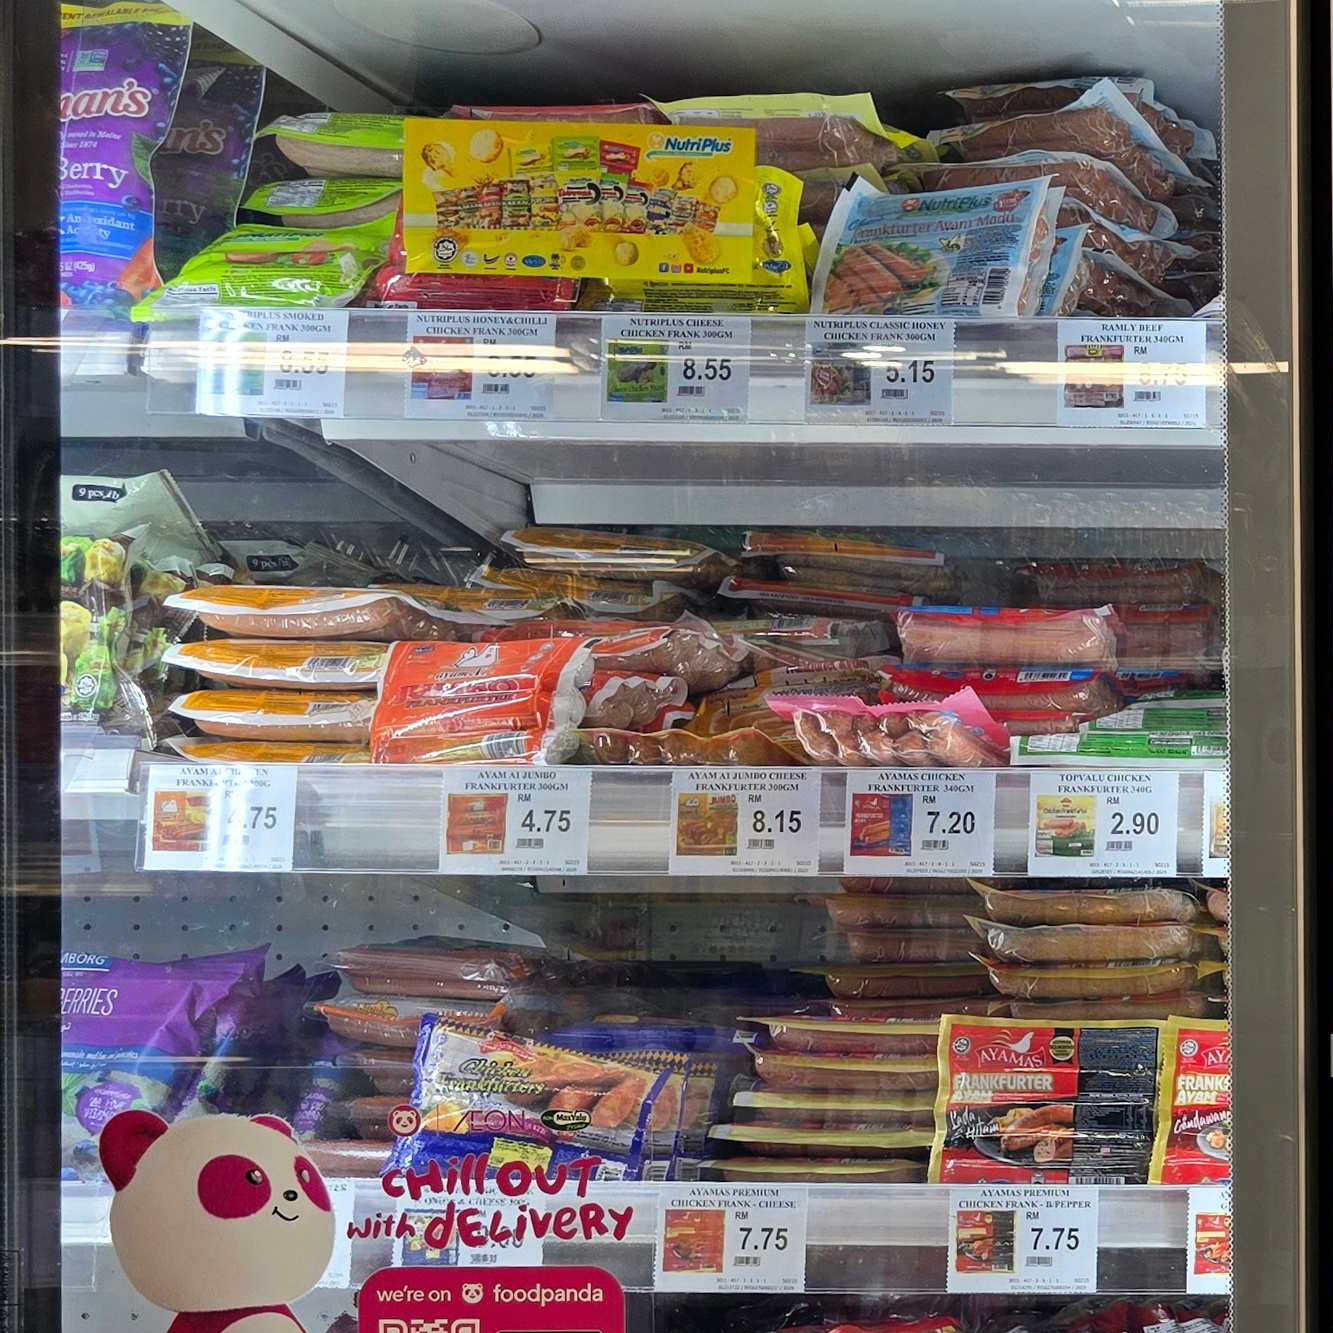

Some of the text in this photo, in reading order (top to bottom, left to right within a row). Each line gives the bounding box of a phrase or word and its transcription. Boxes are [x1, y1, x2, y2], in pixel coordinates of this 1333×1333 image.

[663, 135, 732, 153] NutriPlus
[683, 359, 732, 381] 8.55
[1059, 774, 1151, 782] TOPVALU CHICKEN
[1057, 785, 1153, 793] FRANKFURTER 340G
[521, 810, 570, 833] 4.75
[752, 811, 801, 833] 8.15
[927, 812, 975, 834] 7.20
[1111, 813, 1159, 834] 2.90
[977, 1048, 1044, 1069] AYAMAS
[954, 1073, 1052, 1091] FRANKFURTER
[739, 1228, 788, 1250] 7.75
[428, 1288, 451, 1302] on
[493, 1284, 604, 1306] foodpanda
